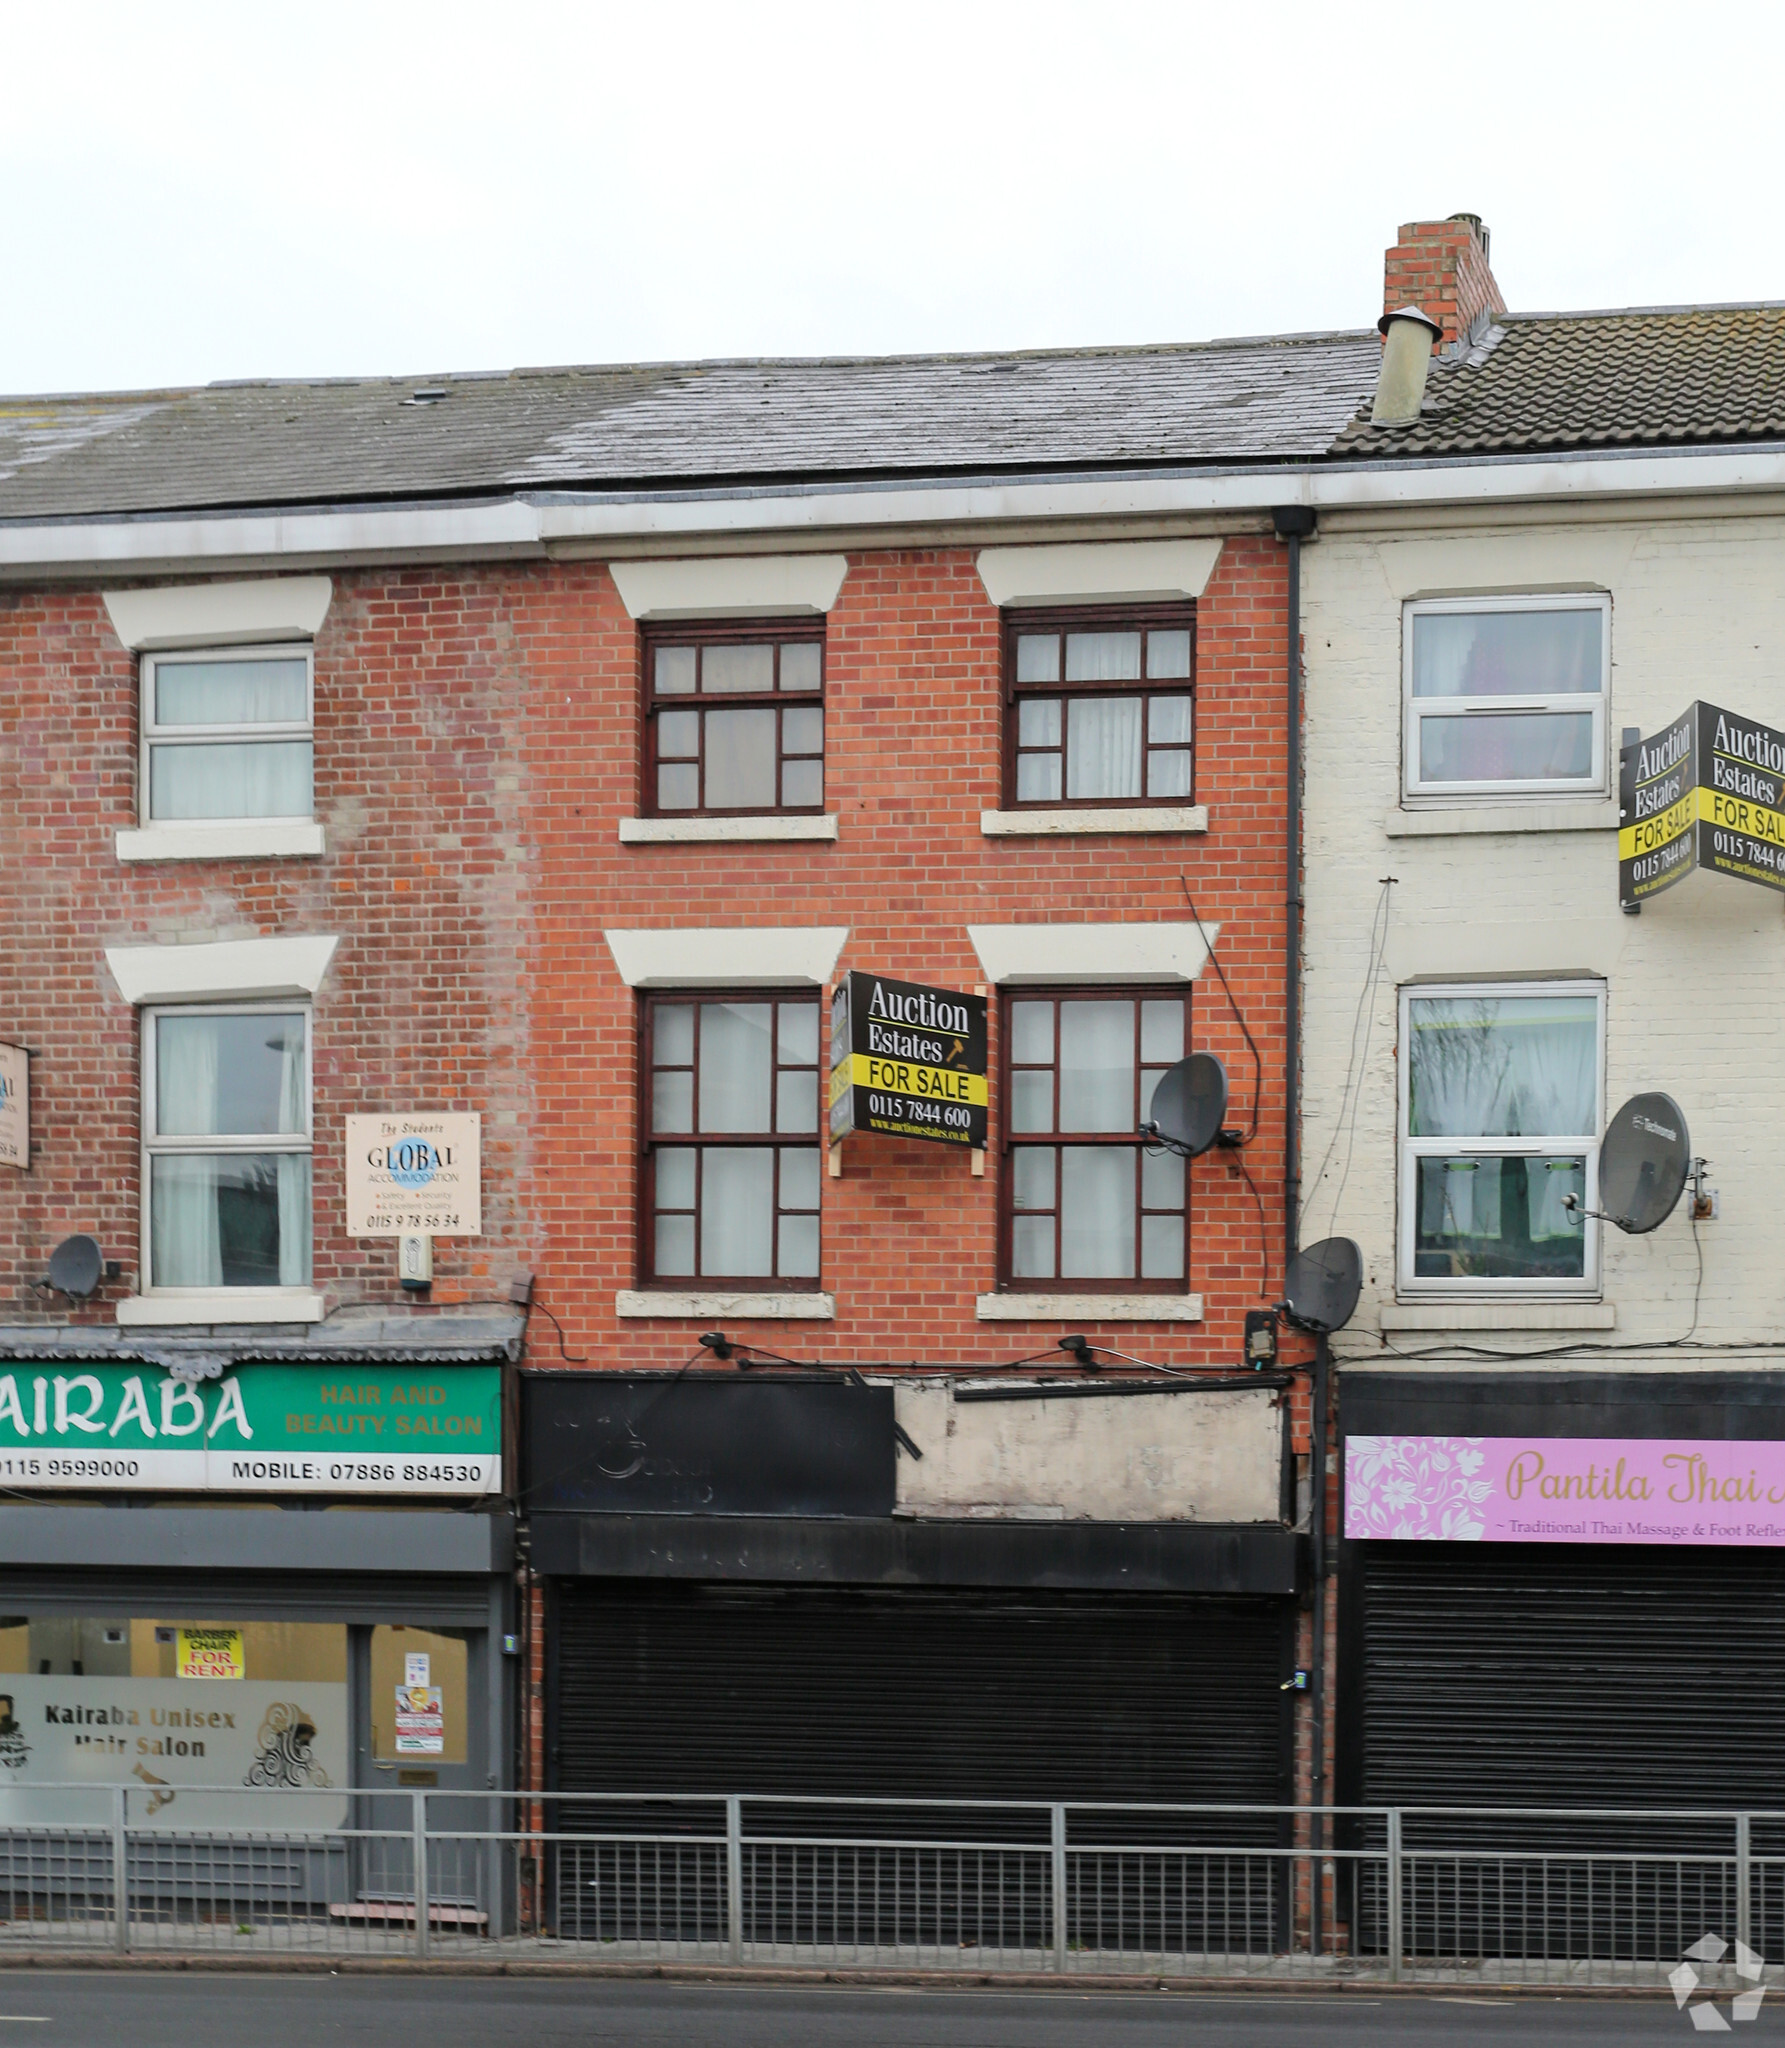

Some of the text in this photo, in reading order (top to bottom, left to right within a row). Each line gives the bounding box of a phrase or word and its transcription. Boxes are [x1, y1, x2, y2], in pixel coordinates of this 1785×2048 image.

[1635, 724, 1690, 783] Auction
[1713, 715, 1785, 773] Auctio
[1713, 757, 1775, 804] Estates
[1635, 775, 1680, 818] Estates
[1635, 798, 1690, 853] FOR SALE
[1715, 796, 1749, 831] FOR
[1714, 831, 1744, 857] 0115
[1746, 841, 1775, 868] 7844
[1633, 855, 1659, 881] 0115
[868, 981, 969, 1033] Auction
[868, 1023, 943, 1063] Estates
[870, 1060, 969, 1100] FOR SALE
[869, 1094, 971, 1128] 0115 7844 600
[381, 1122, 444, 1134] The Students
[367, 1144, 457, 1171] GLOBAL
[368, 1172, 459, 1183] ACCOMMODATION
[366, 1213, 460, 1228] 0115 9 78 56 34
[320, 1384, 447, 1405] HAIR AND
[286, 1413, 482, 1435] BEAUTY SALON
[0, 1460, 139, 1476] 115 9599000
[232, 1461, 481, 1481] MOBILE: 07886 884530
[1506, 1450, 1763, 1503] Pantila Thai
[1510, 1519, 1785, 1539] Traditional Thai Massage & Foot Refle
[184, 1629, 237, 1640] BARBER
[190, 1640, 232, 1651] CHAIR
[191, 1651, 232, 1664] FOR
[184, 1664, 240, 1677] RENT
[46, 1705, 236, 1729] Kairaba Unisex
[75, 1735, 205, 1757] Hair Salon
